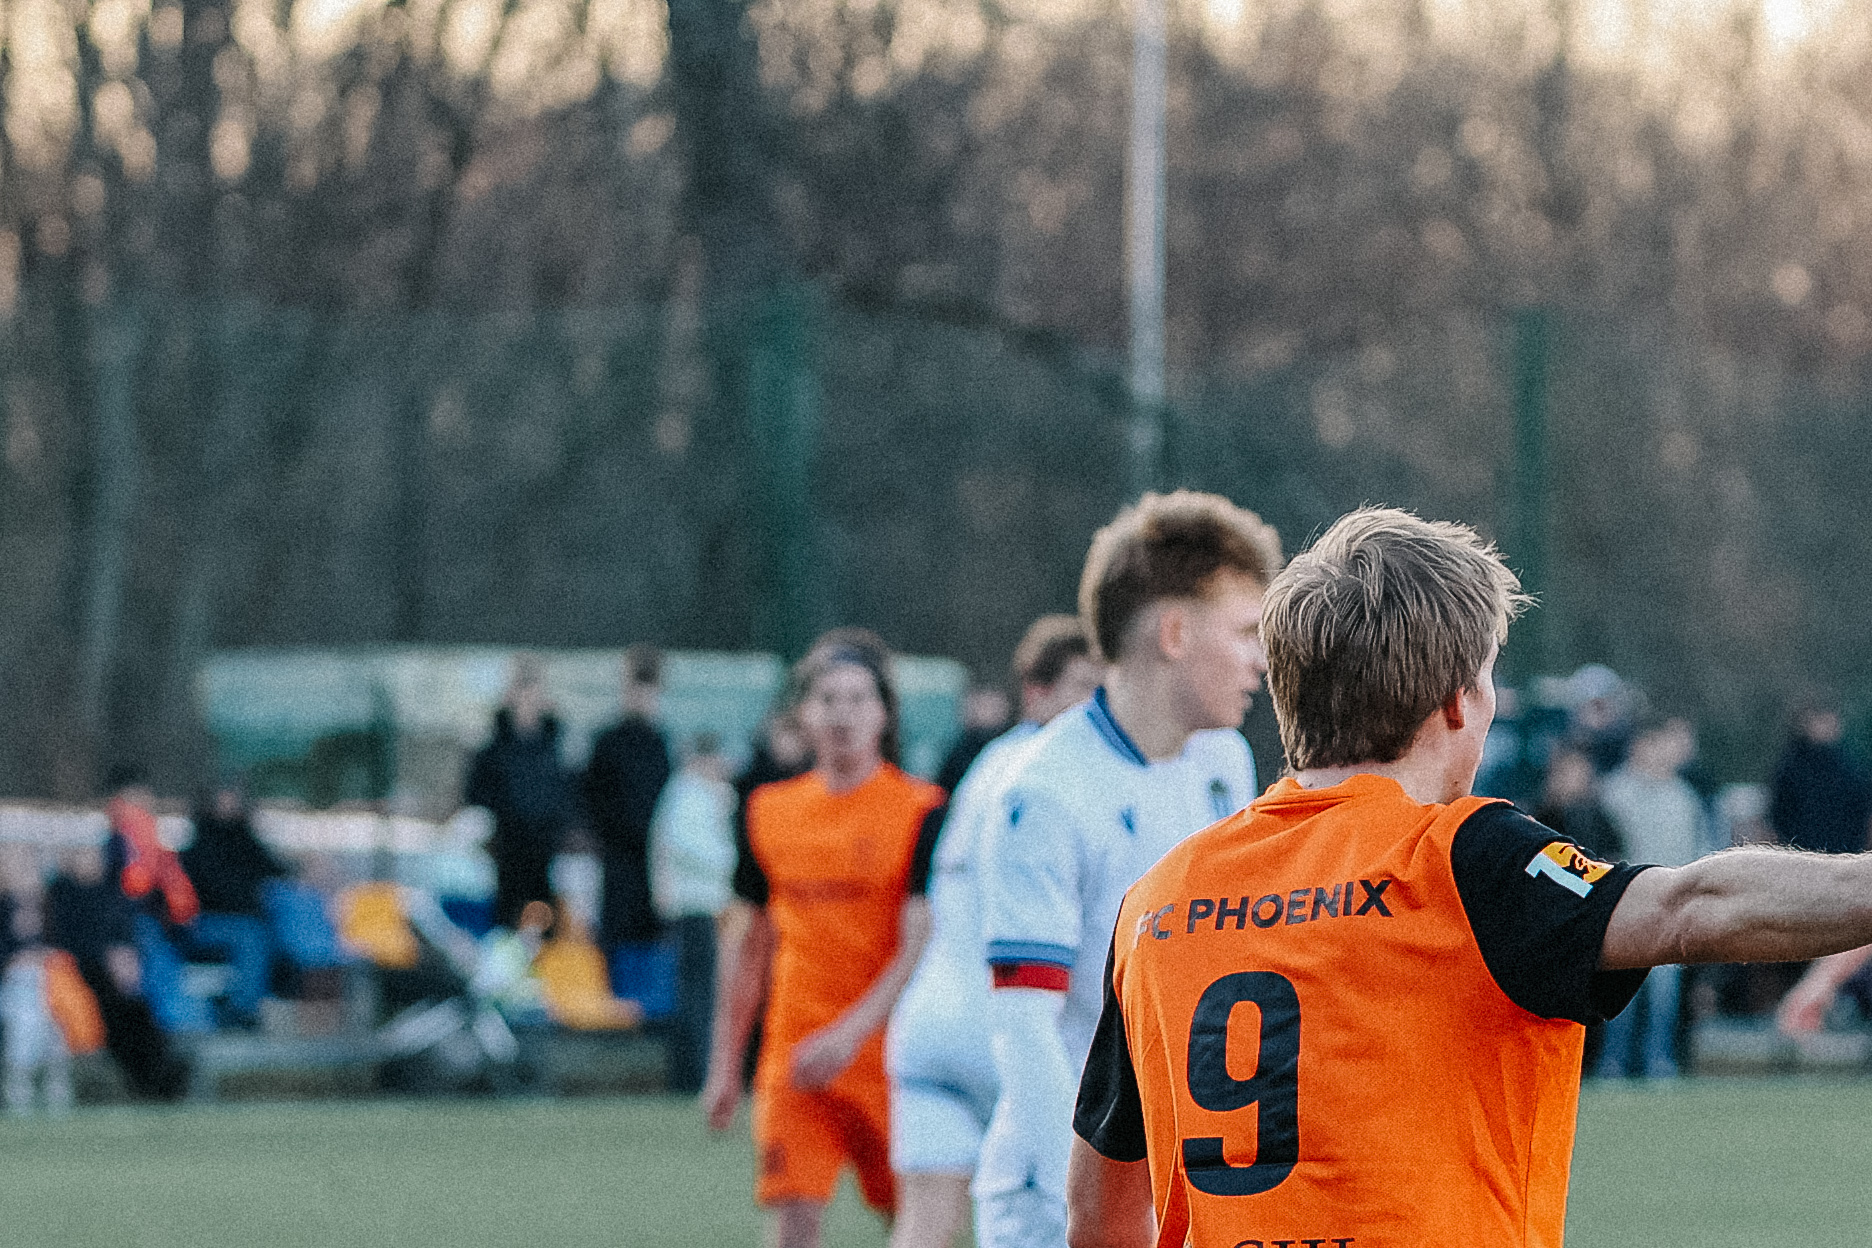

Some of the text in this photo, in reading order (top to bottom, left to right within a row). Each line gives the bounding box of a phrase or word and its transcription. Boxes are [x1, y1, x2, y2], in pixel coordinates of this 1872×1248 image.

[1132, 878, 1395, 950] FC PHOENIX
[1181, 970, 1302, 1197] 9
